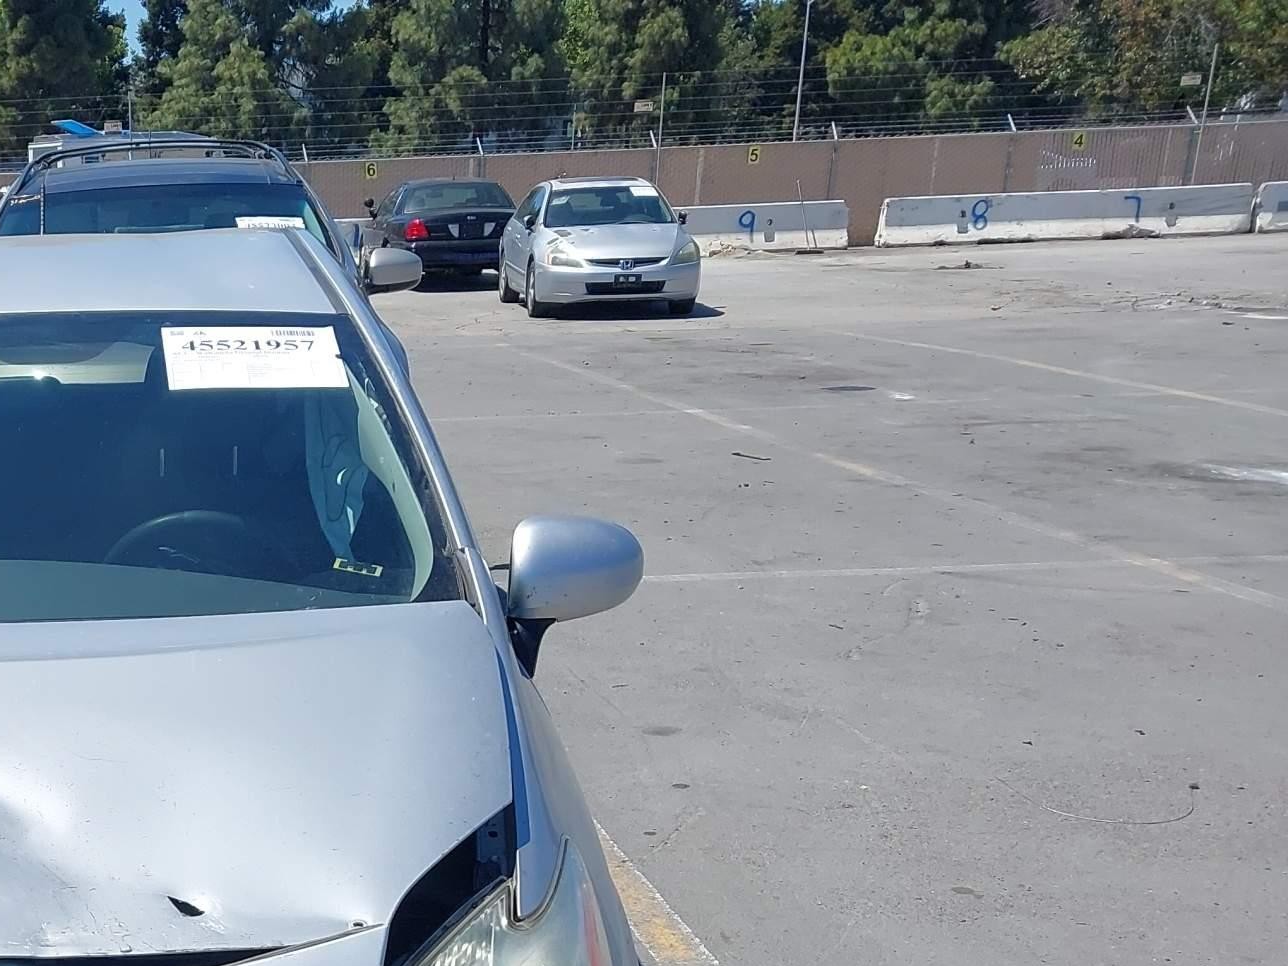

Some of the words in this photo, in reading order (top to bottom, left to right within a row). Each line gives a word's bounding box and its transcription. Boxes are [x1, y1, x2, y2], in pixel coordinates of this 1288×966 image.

[1073, 134, 1085, 148] 4
[750, 149, 759, 162] 5
[367, 163, 376, 177] 6
[972, 199, 989, 231] 8
[1123, 196, 1141, 223] 7
[738, 210, 756, 240] 9
[181, 339, 314, 351] 45521957
